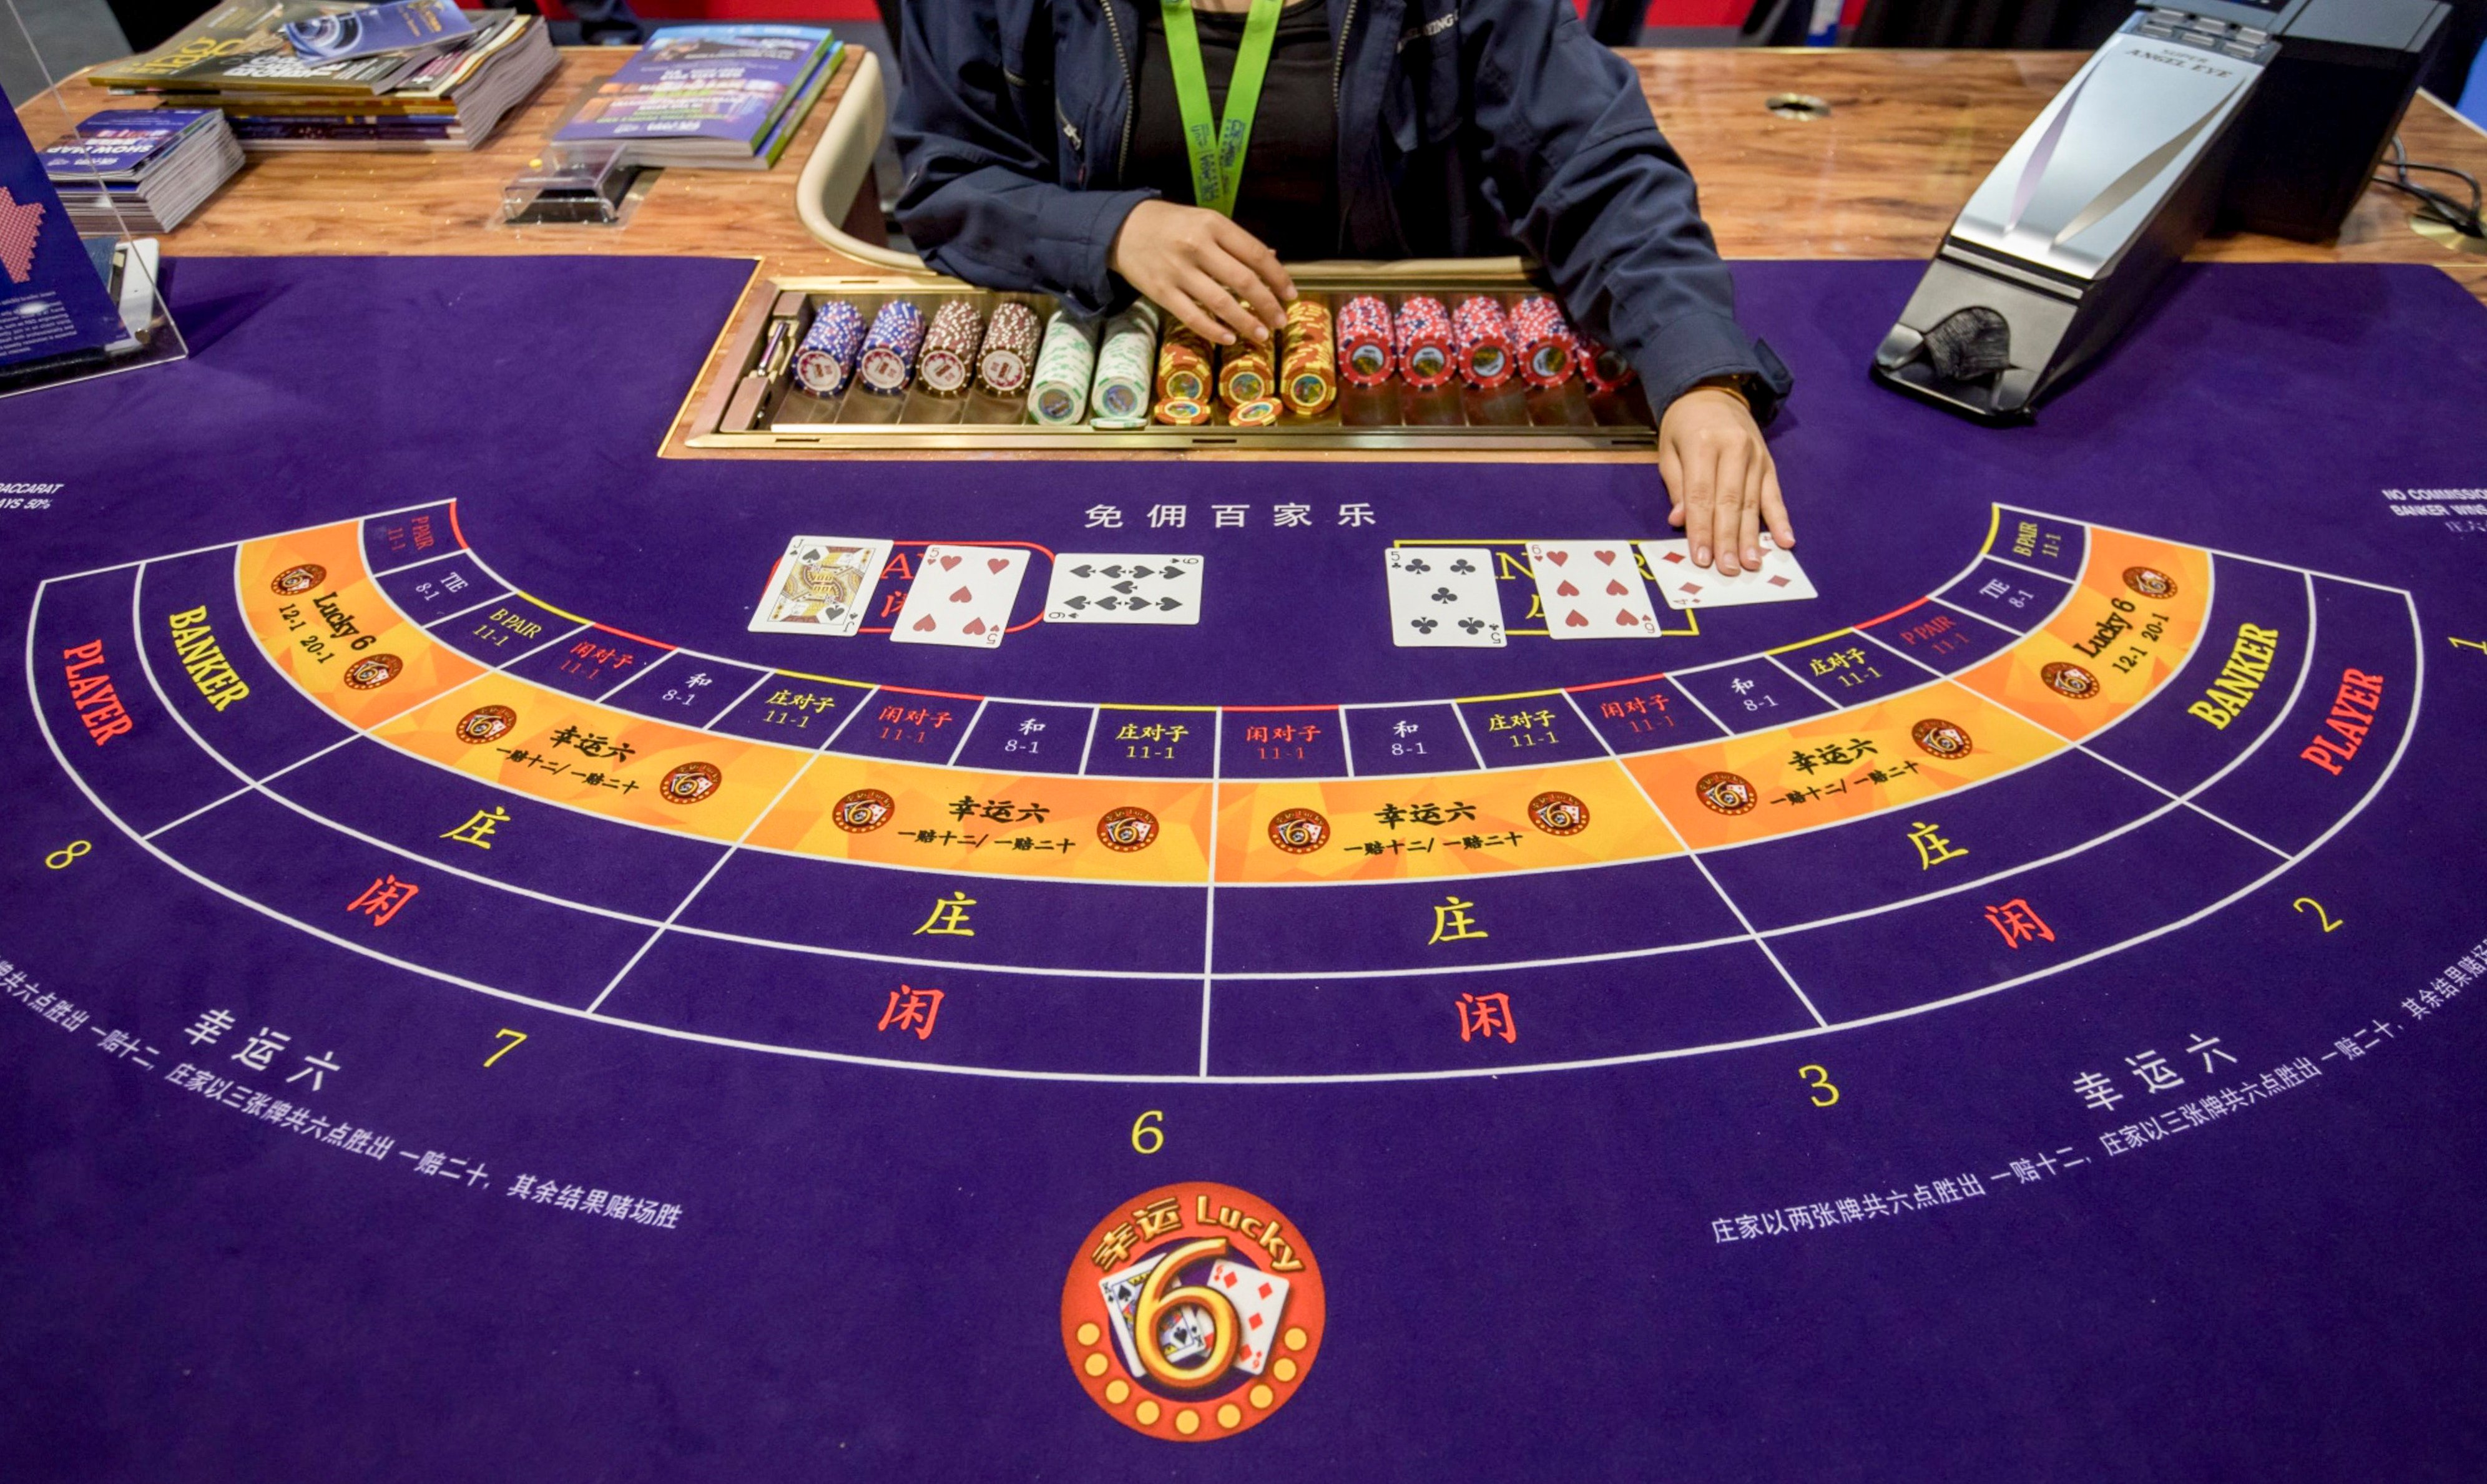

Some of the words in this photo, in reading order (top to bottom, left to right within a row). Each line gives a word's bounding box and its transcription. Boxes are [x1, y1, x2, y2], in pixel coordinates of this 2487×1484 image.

[2126, 49, 2185, 69] ANGEL
[2190, 64, 2234, 79] EYE
[24, 498, 53, 509] 50%
[2382, 489, 2407, 500] NO
[2407, 489, 2487, 500] COMMISSIO
[1084, 502, 1376, 529] 免佣百家乐
[2390, 504, 2450, 516] BANKER
[386, 527, 406, 550] 11-1
[793, 539, 805, 549] J
[2016, 520, 2038, 547] PAIR
[2042, 534, 2061, 558] 11-1
[929, 547, 940, 558] 5
[1391, 551, 1400, 562] 5
[1531, 544, 1542, 555] 6
[2012, 544, 2033, 557] B
[415, 582, 440, 601] 8-1
[440, 571, 469, 593] TIE
[1979, 578, 2010, 599] TIE
[2008, 590, 2034, 608] 8-1
[278, 603, 307, 632] 12-1
[300, 634, 336, 664] 20-1
[313, 591, 360, 639] Lucky
[350, 635, 377, 651] 6
[489, 607, 509, 622] B
[501, 614, 542, 639] PAIR
[2071, 612, 2134, 659] Lucky
[2111, 598, 2136, 613] 6
[473, 623, 511, 647] 11-1
[1931, 632, 1969, 655] 11-1
[2112, 646, 2147, 674] 12-1
[2141, 613, 2169, 642] 20-1
[2448, 637, 2487, 655] 1
[168, 602, 251, 714] BANKER
[560, 657, 601, 680] 11-1
[568, 642, 633, 671] 闲对子
[1809, 648, 1868, 678] 庄对子
[685, 673, 713, 688] 和
[1731, 678, 1755, 695] 和
[1838, 665, 1881, 687] 11-1
[2187, 620, 2280, 731] BANKER
[63, 638, 133, 746] PLAYER
[662, 689, 695, 706] 8-1
[765, 690, 835, 716] 庄对子
[1742, 693, 1778, 711] 8-1
[763, 708, 809, 728] 11-1
[878, 705, 953, 730] 闲对子
[1601, 694, 1670, 720] 闲对子
[1019, 718, 1046, 736] 和
[1115, 723, 1189, 743] 庄对子
[1393, 720, 1419, 738] 和
[1489, 710, 1556, 735] 庄对子
[1629, 715, 1675, 733] 11-1
[2298, 665, 2386, 777] PLAYER
[549, 725, 635, 764] 幸运六
[880, 727, 925, 743] 11-1
[1004, 739, 1038, 754] 8-1
[1246, 725, 1321, 743] 闲对子
[1509, 731, 1559, 748] 11-1
[1127, 746, 1175, 759] 11-1
[1257, 747, 1305, 759] 11-1
[1391, 742, 1427, 756] 8-1
[1788, 738, 1880, 777] 幸运六
[571, 771, 639, 794] 一赔二十
[1852, 758, 1918, 785] 一赔二十
[949, 795, 1050, 824] 幸运六
[1374, 801, 1476, 830] 幸运六
[439, 806, 511, 849] 庄
[994, 837, 1076, 854] 一赔二十
[1443, 831, 1523, 850] 一赔二十
[1906, 821, 1969, 871] 庄
[44, 840, 92, 869] 8
[346, 874, 419, 927] 闲
[912, 891, 977, 937] 庄
[1428, 896, 1488, 945] 庄
[1984, 898, 2056, 949] 闲
[2293, 897, 2343, 933] 2
[877, 984, 945, 1040] 闲
[1455, 992, 1517, 1044] 闲
[182, 1009, 341, 1094] 幸运六
[483, 1028, 527, 1068] 7
[1798, 1064, 1840, 1107] 3
[2072, 1033, 2240, 1114] 幸运六
[1131, 1110, 1164, 1154] 6
[1092, 1198, 1182, 1272] 幸运
[1196, 1194, 1306, 1272] Lucky
[1134, 1237, 1242, 1388] 6
